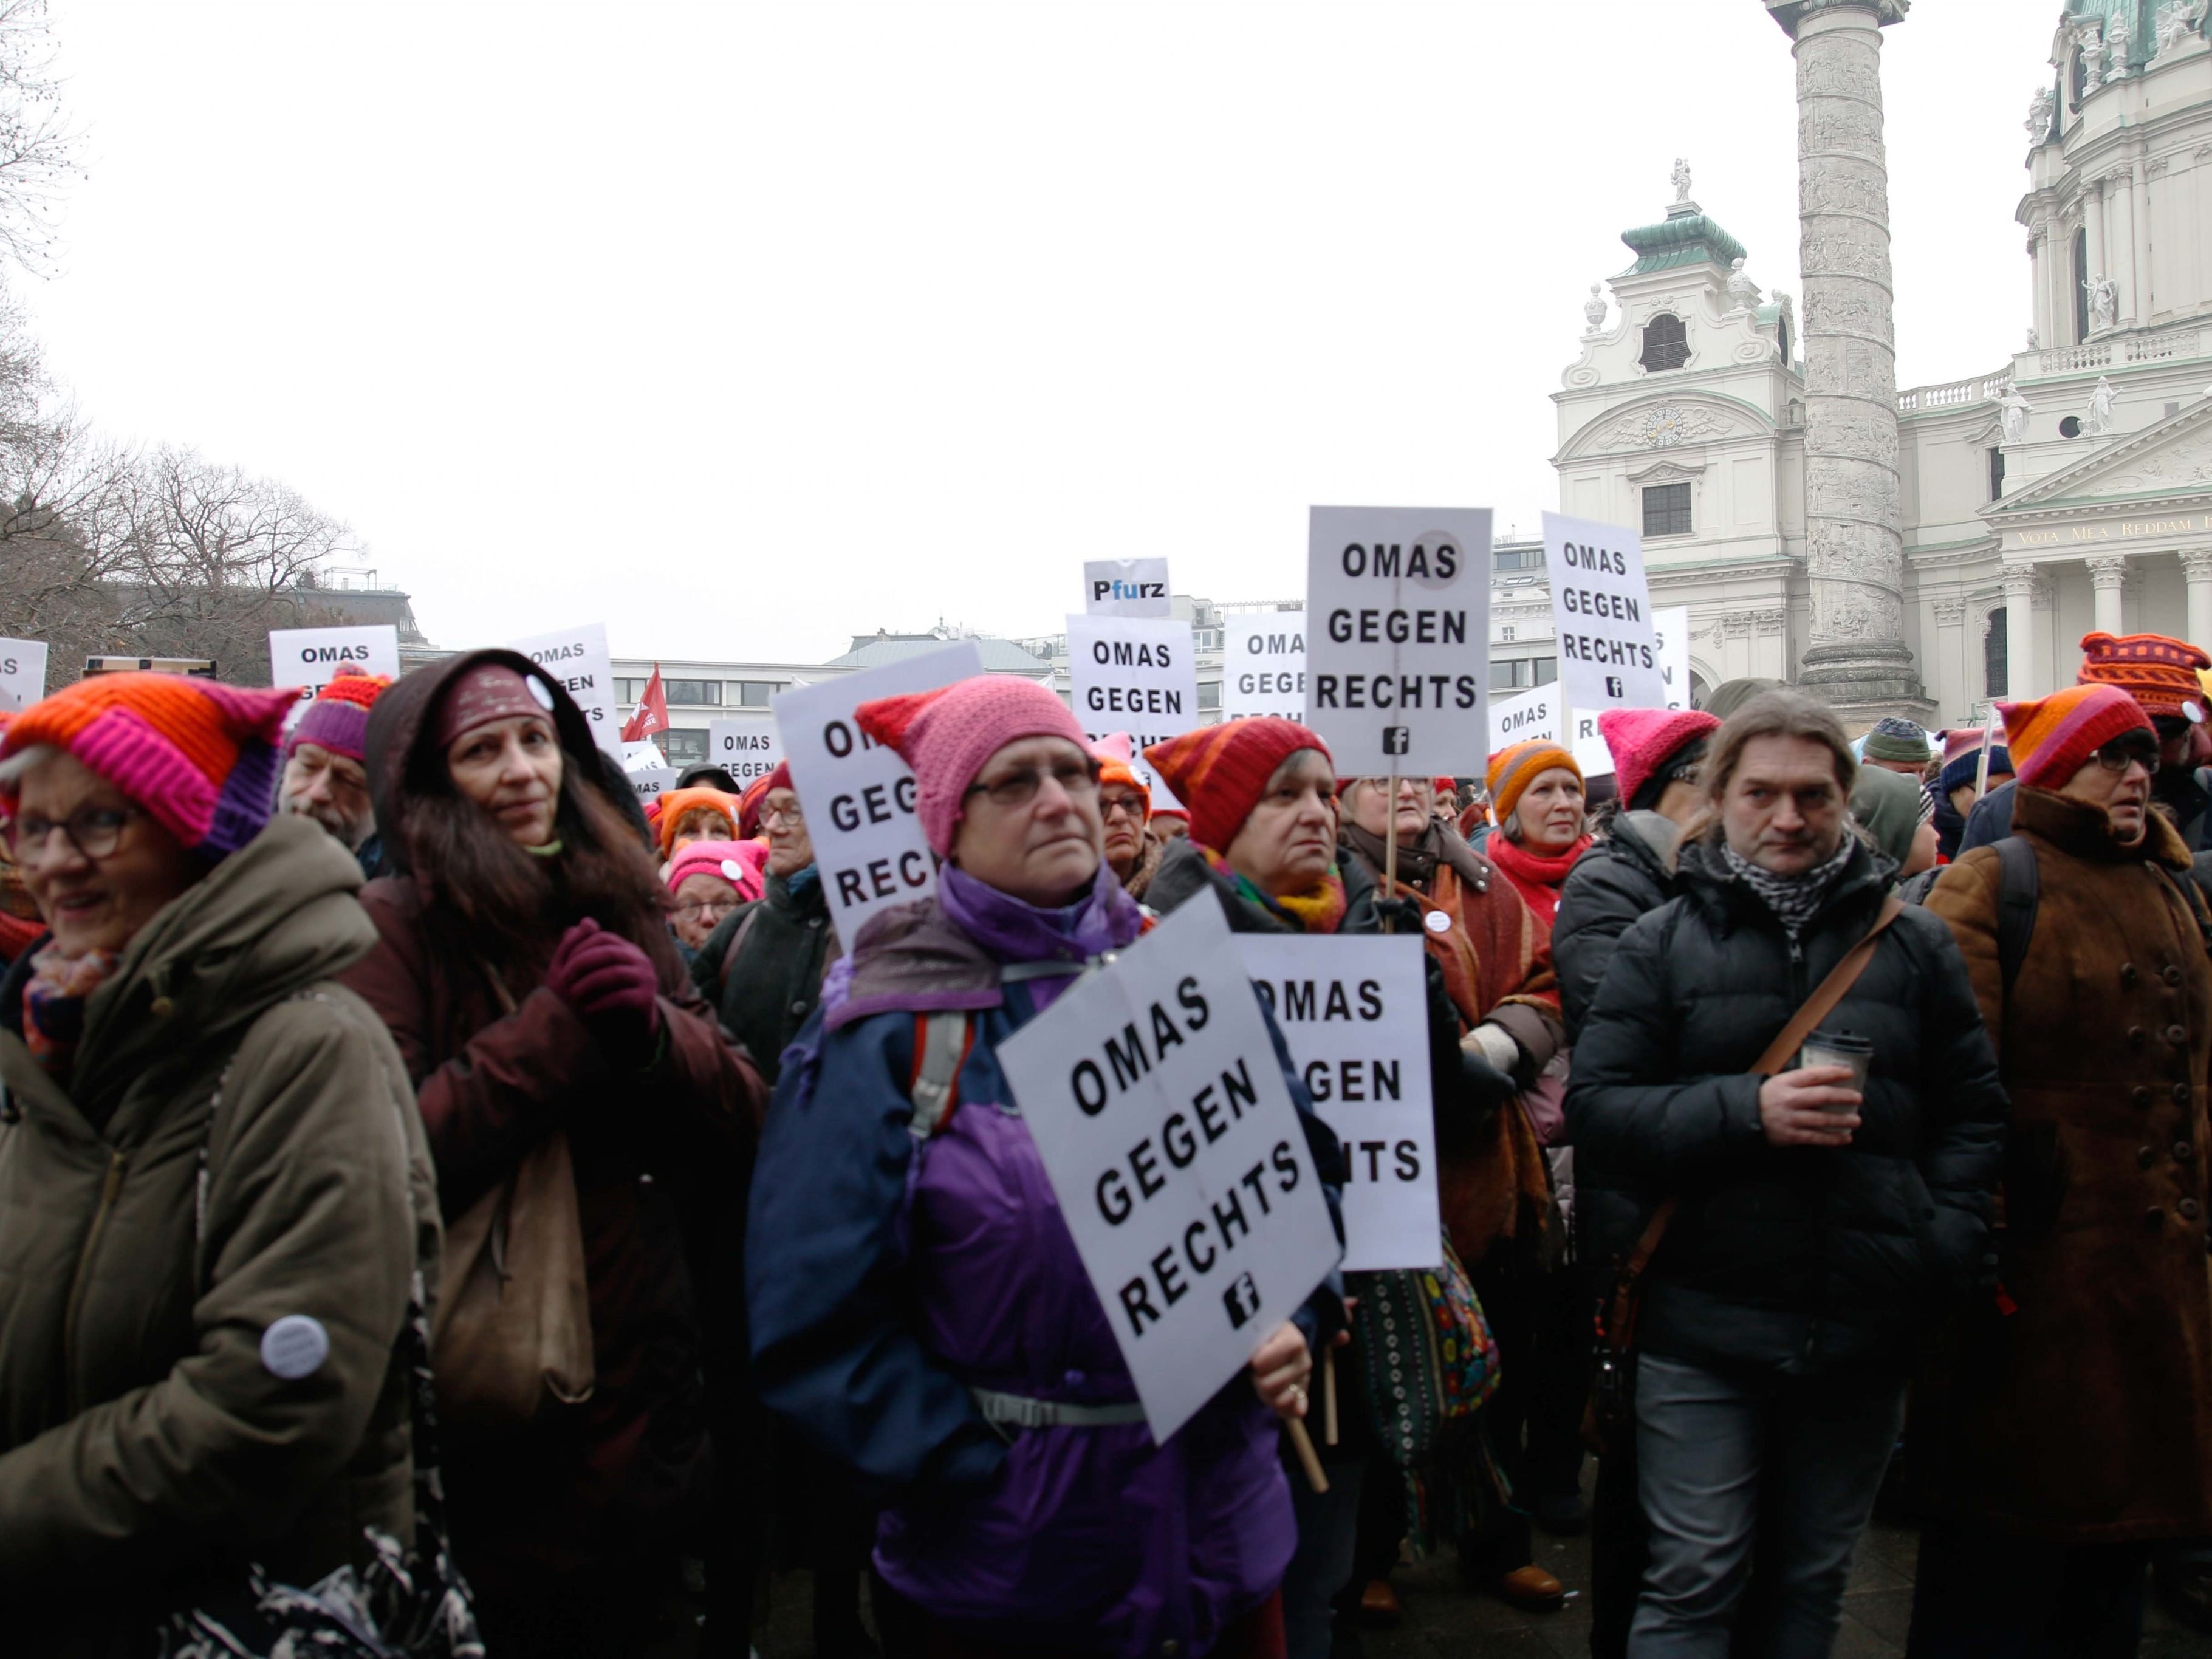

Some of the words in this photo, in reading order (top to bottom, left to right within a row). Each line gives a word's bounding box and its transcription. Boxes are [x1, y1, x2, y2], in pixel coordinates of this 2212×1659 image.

[2072, 527, 2109, 541] MEA
[2123, 519, 2191, 536] REDDAM
[1343, 542, 1456, 578] OMAS
[1564, 542, 1626, 576] OMAS
[1094, 579, 1165, 601] Pfurz
[1563, 587, 1640, 623] GEGEN
[1329, 609, 1465, 643] GEGEN
[301, 645, 369, 663] OMAS
[530, 643, 584, 665] OMAS
[1094, 641, 1171, 668] OMAS
[1248, 633, 1306, 655] OMA
[1563, 633, 1654, 669] RECHTS
[1087, 686, 1182, 714] GEGEN
[1316, 674, 1476, 708] RECHTS
[1502, 703, 1547, 733] OMAS
[724, 735, 770, 750] OMAS
[835, 850, 927, 909] REC
[1071, 976, 1210, 1117] OMAS
[1305, 1059, 1401, 1102] GEN
[1096, 1058, 1259, 1228] GEGEN
[1118, 1140, 1299, 1337] RECHTS
